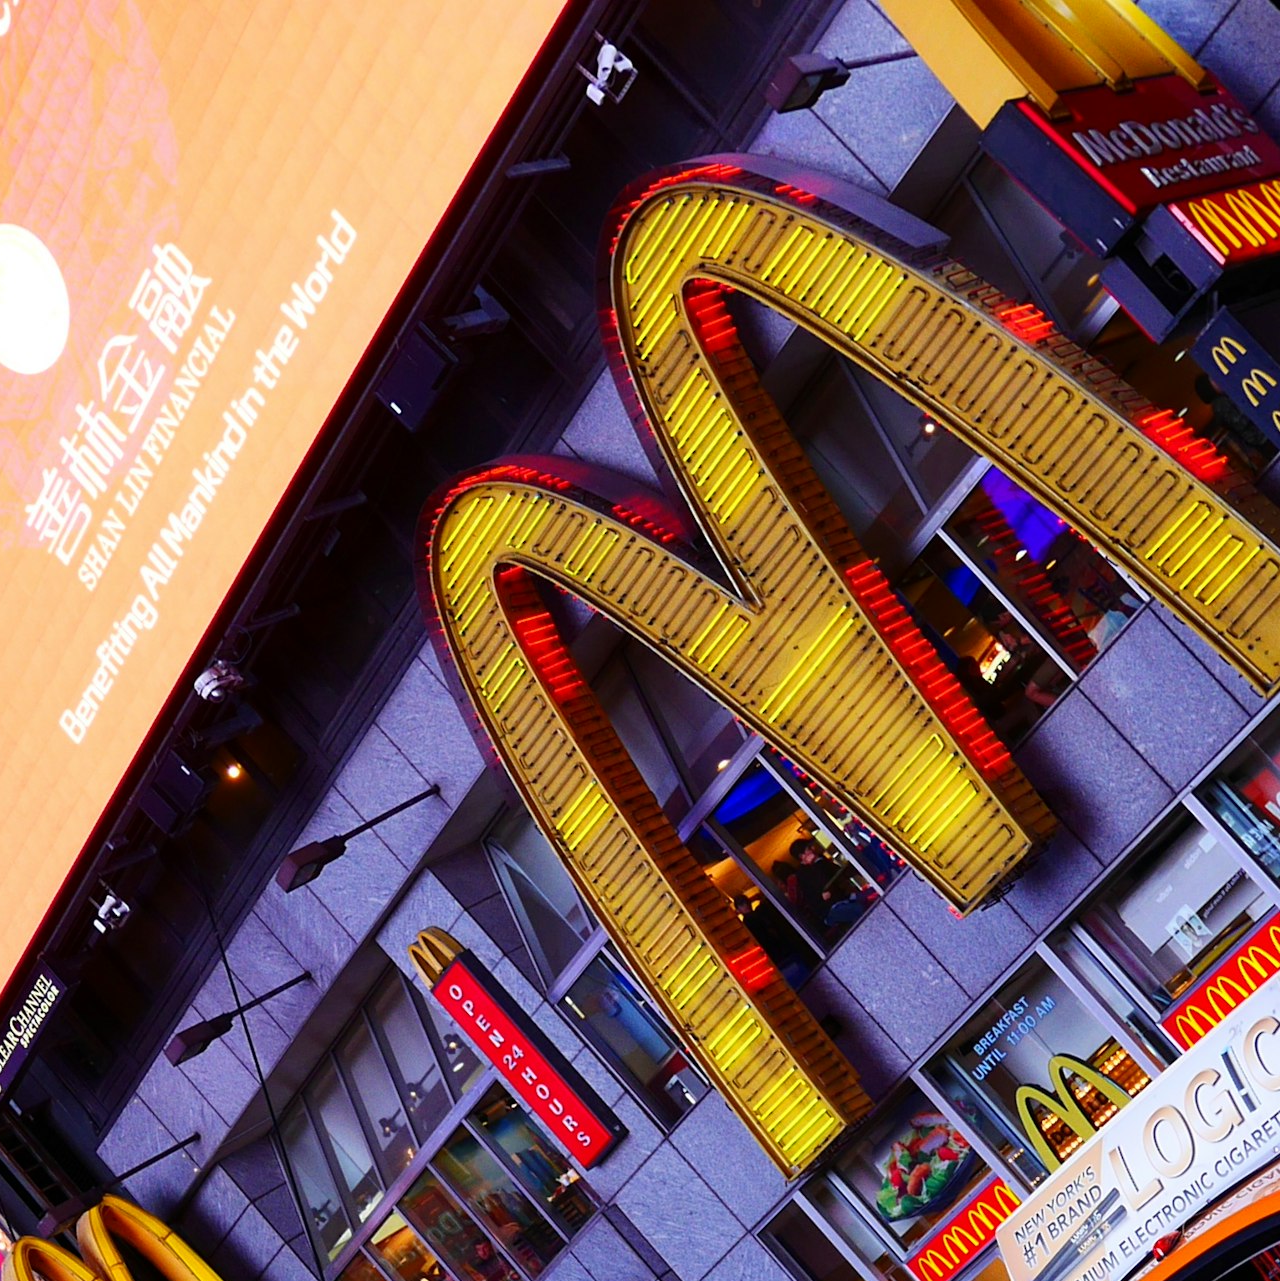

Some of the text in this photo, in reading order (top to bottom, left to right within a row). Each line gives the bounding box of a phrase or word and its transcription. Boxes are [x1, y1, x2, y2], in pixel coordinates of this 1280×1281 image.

[1072, 105, 1259, 168] McDonald's
[1140, 142, 1262, 188] Restaurant
[24, 243, 212, 566] 善林金融
[58, 209, 357, 745] Benefiting All Mankind in the World
[78, 305, 237, 592] SHAN LIN FINANCIAL
[19, 985, 60, 1049] SPECTACOLOR
[972, 995, 1055, 1081] UNTIL 11:00 AM
[973, 996, 1029, 1056] BREAKFAST
[449, 984, 591, 1147] OPEN 24 HOURS
[1015, 1208, 1045, 1244] NEW
[1046, 1165, 1095, 1213] YORK'S
[1023, 1232, 1047, 1263] #1
[1048, 1184, 1104, 1240] BRAND
[1118, 1171, 1214, 1258] ELECTRONIC
